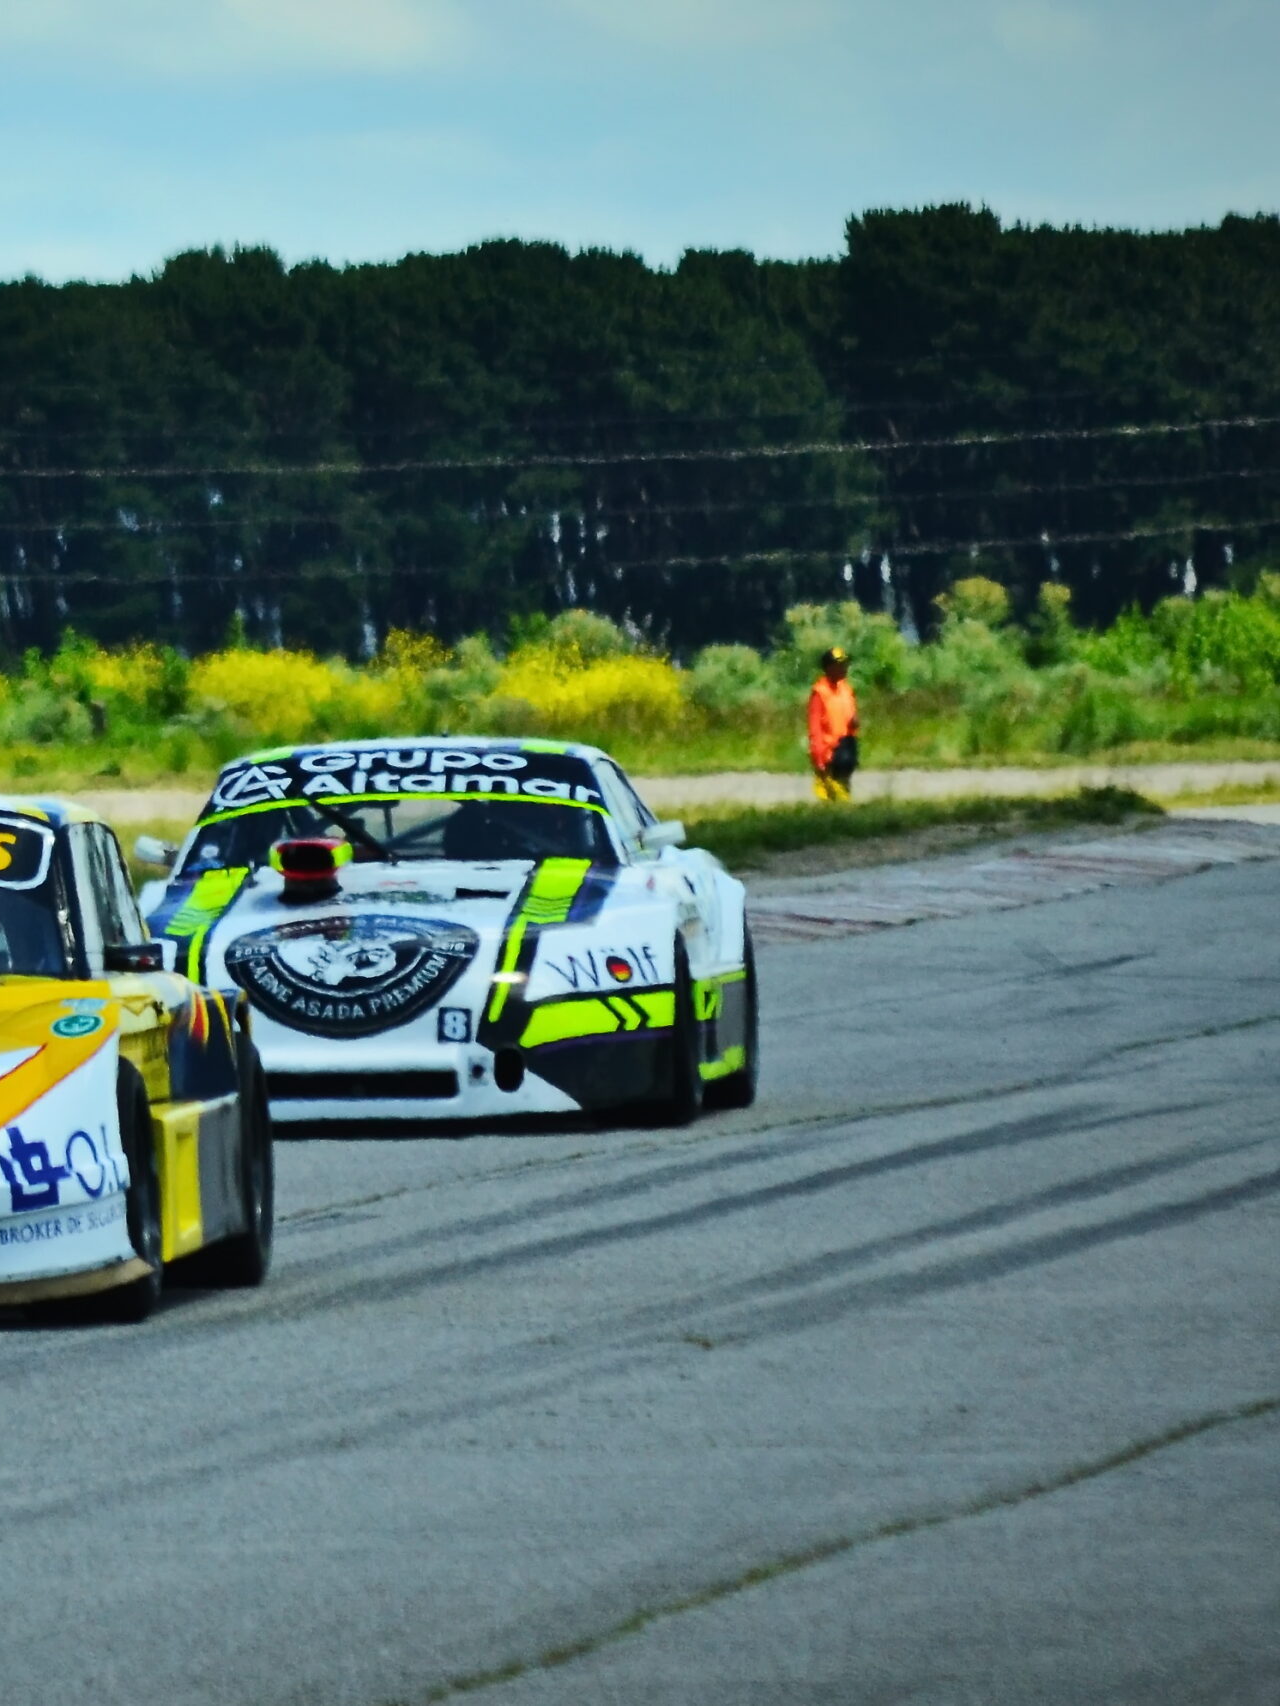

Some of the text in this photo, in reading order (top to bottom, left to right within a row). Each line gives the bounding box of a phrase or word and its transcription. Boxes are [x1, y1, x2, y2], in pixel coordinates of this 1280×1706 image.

[299, 748, 528, 773] Grupo
[301, 769, 601, 803] Altamar
[249, 953, 448, 1020] CARNE ASADA PREMIUM
[441, 1010, 469, 1041] 8
[0, 1218, 63, 1246] BROKER
